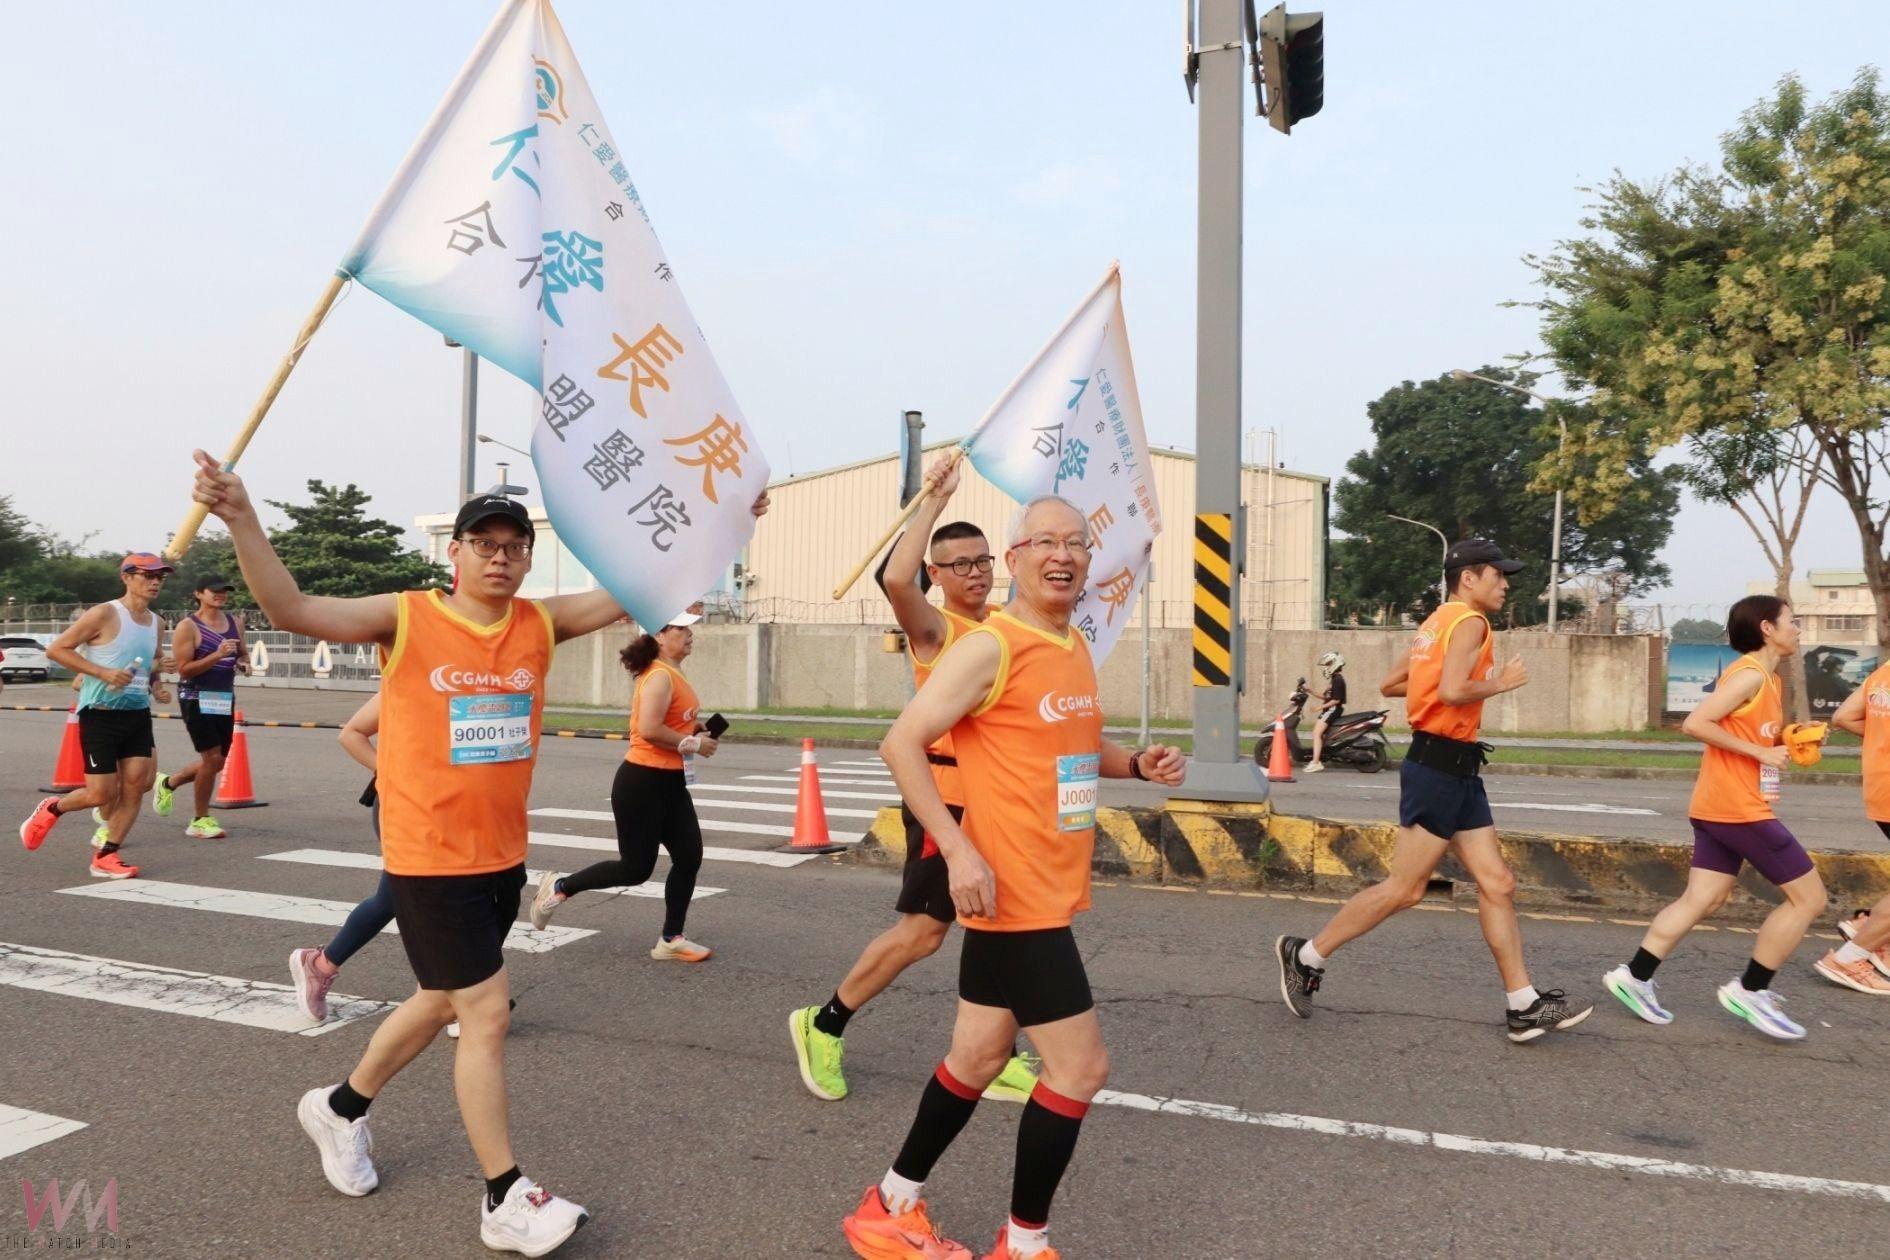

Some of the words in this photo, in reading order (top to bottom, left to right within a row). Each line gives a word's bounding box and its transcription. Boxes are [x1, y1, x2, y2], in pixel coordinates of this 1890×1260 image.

[450, 671, 502, 687] CGMH
[1058, 695, 1093, 711] CGMH
[454, 726, 505, 742] 90001
